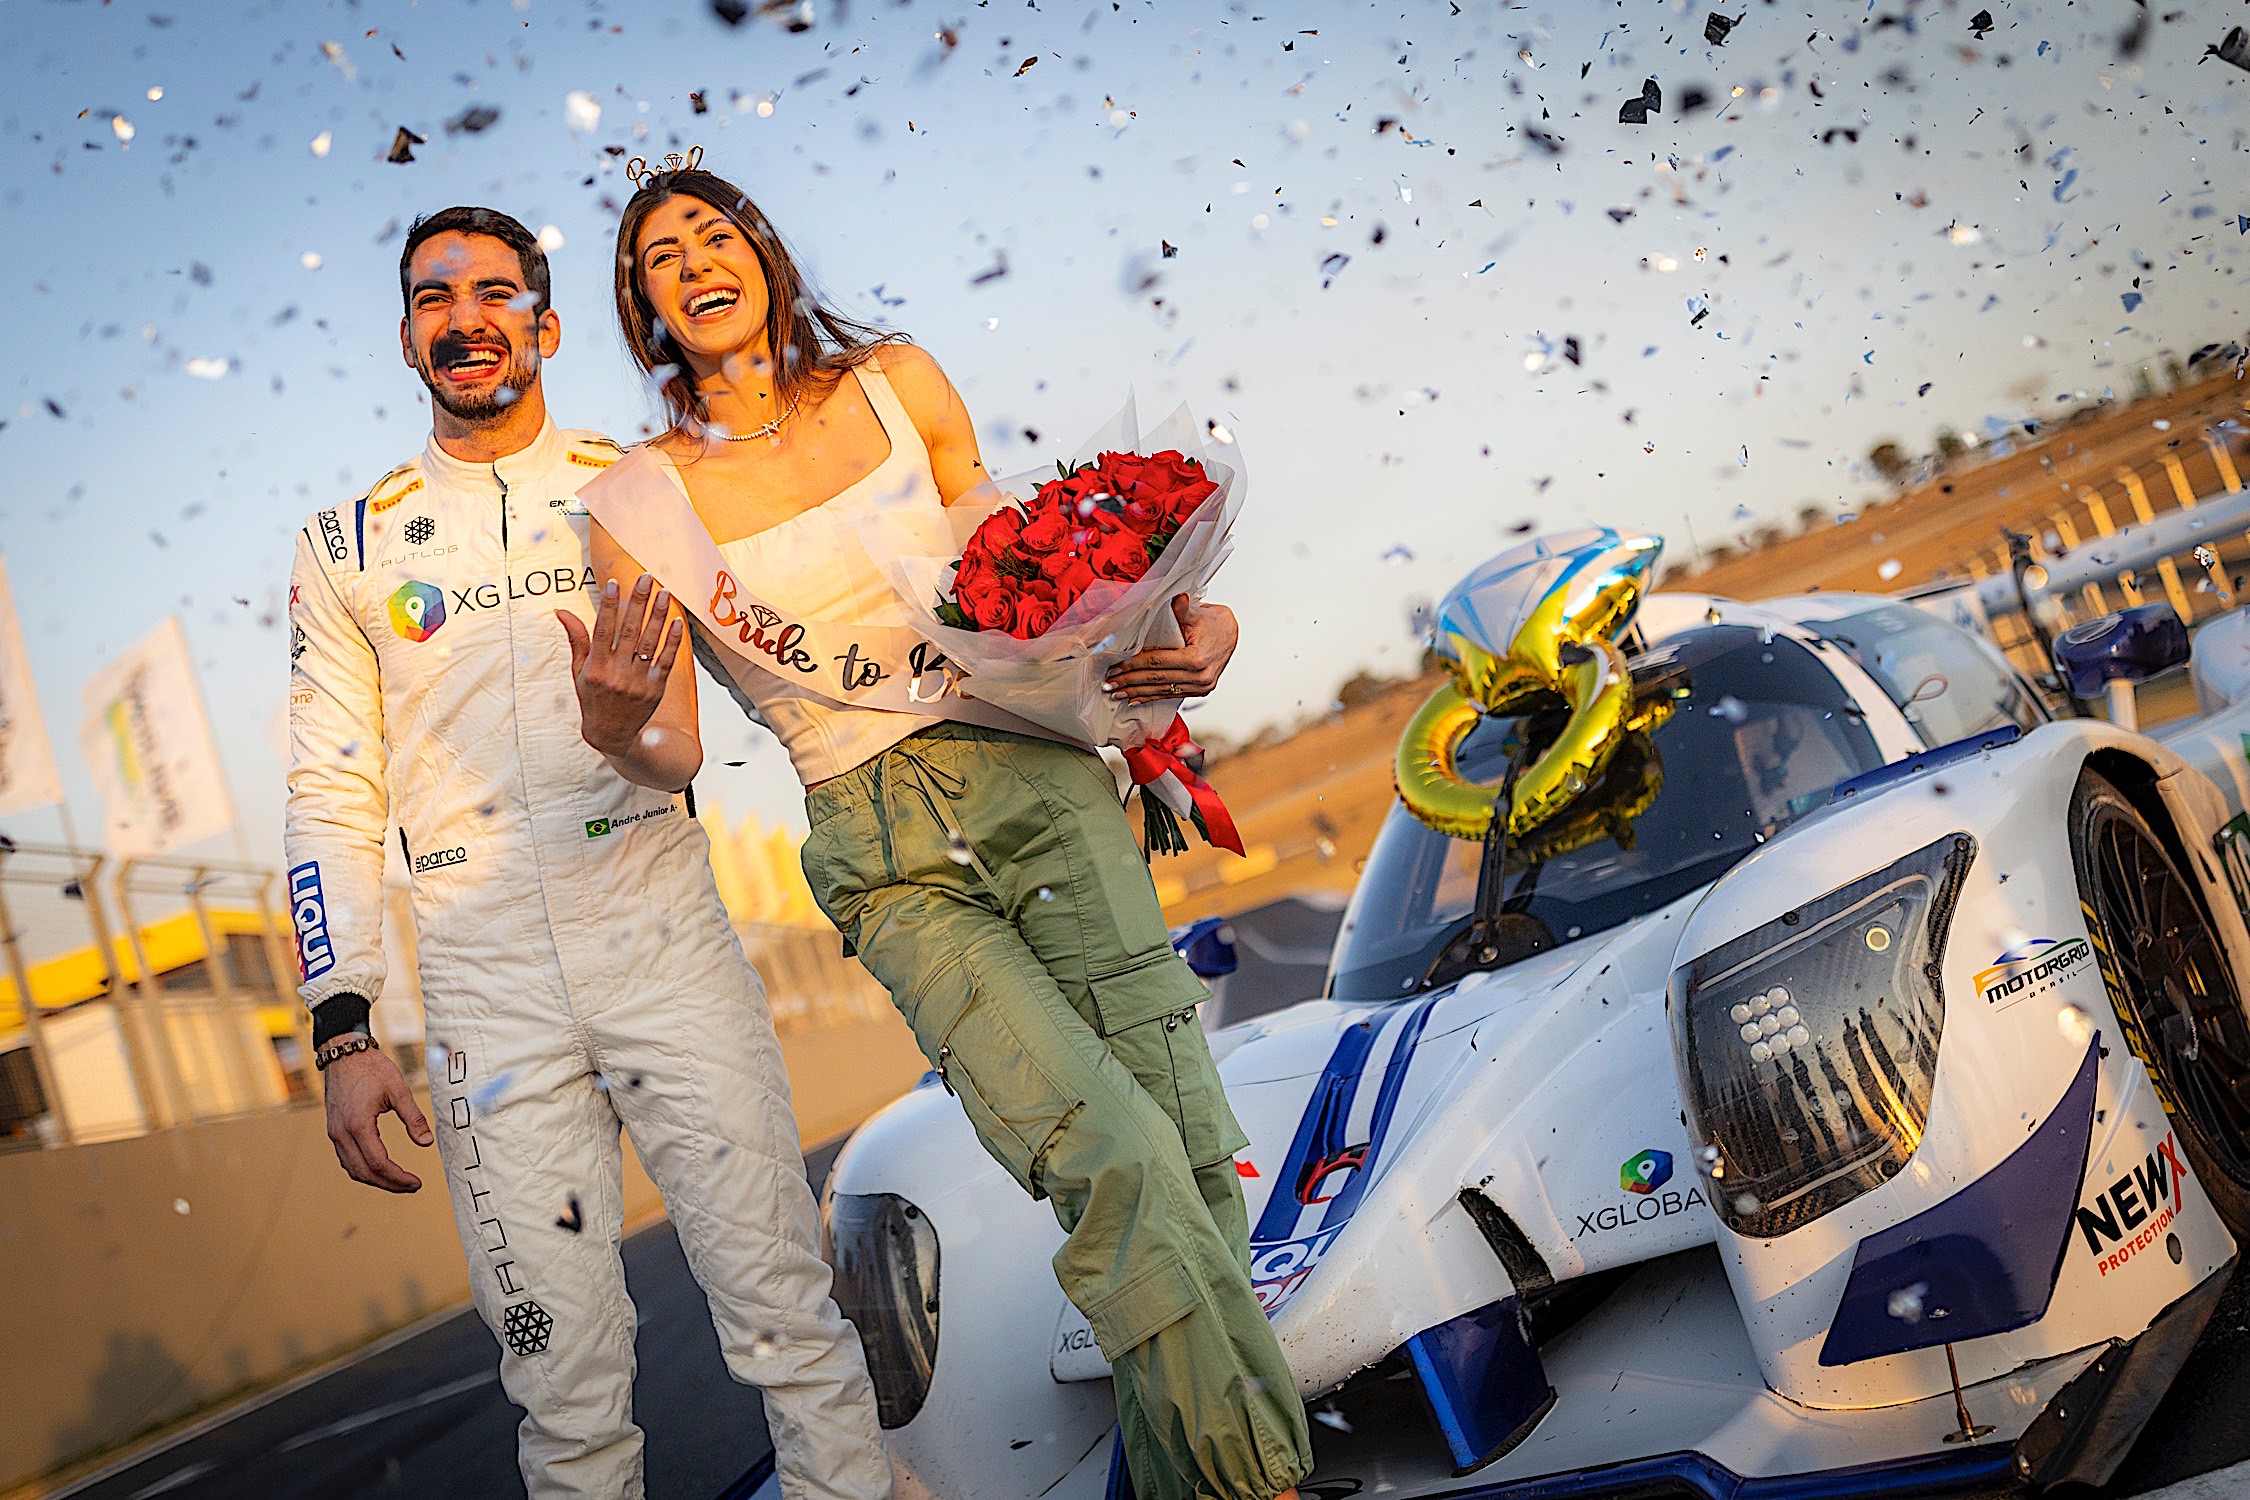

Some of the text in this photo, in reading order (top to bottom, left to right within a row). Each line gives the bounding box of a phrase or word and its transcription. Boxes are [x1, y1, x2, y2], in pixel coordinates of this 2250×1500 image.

[318, 507, 348, 561] parco
[381, 544, 459, 569] AUTLOG
[709, 570, 819, 673] Bride
[834, 643, 890, 691] to
[610, 813, 641, 829] André
[642, 806, 669, 820] Junior
[415, 846, 468, 873] sparco
[290, 865, 334, 977] LIQUI
[1985, 941, 2091, 1005] MOTORGRID
[2029, 971, 2078, 999] BRASIL
[2097, 1205, 2175, 1278] PROTECTION
